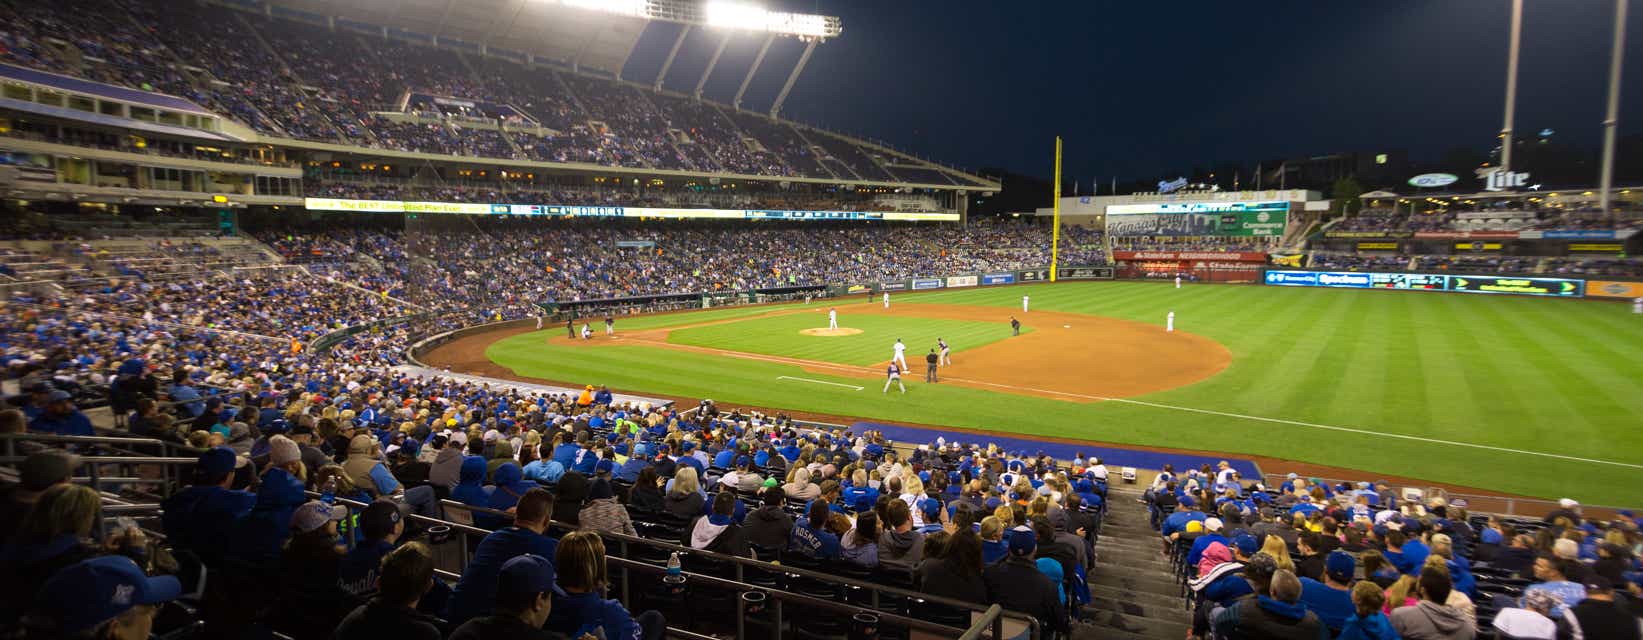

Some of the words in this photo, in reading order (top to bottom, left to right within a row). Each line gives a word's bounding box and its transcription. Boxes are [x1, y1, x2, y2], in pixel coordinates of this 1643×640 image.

[1486, 171, 1530, 191] Lite
[1108, 218, 1157, 233] Kansas
[1156, 213, 1185, 229] City
[796, 527, 822, 549] HOSMER
